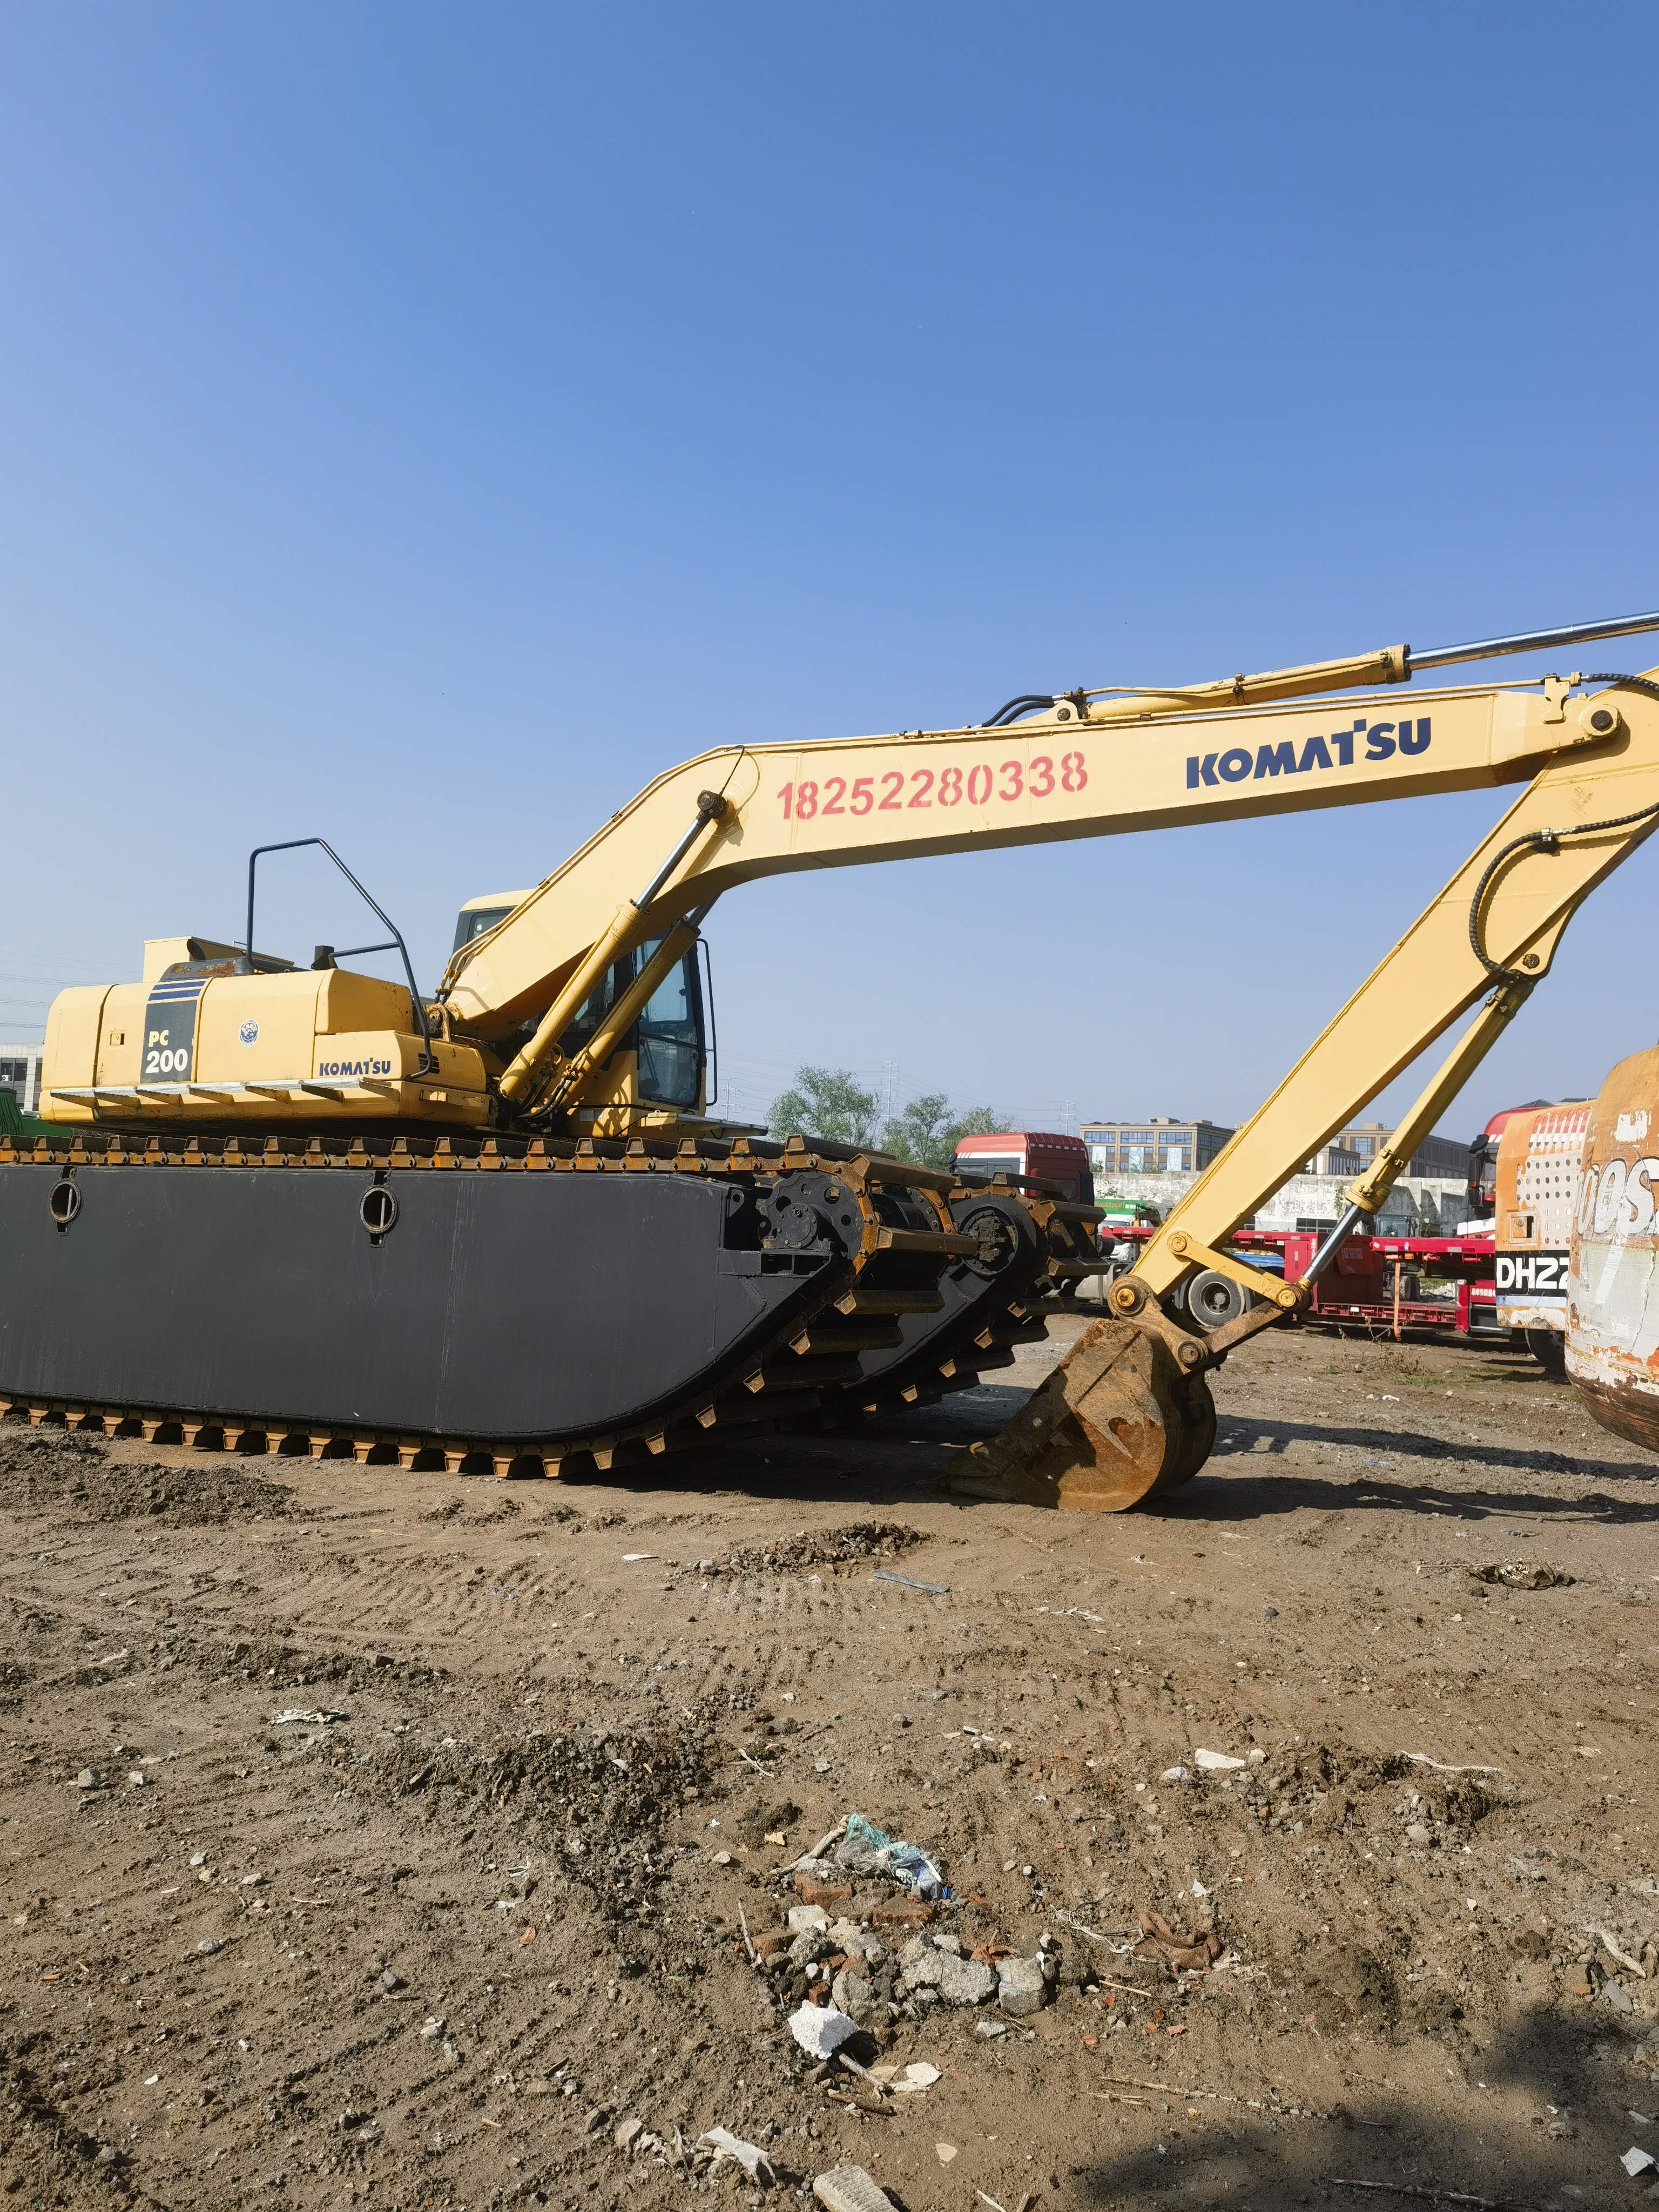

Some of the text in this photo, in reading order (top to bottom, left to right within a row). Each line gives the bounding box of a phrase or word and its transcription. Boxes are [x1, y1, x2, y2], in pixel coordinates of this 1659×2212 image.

[1186, 717, 1431, 789] KOMATSU
[777, 751, 1088, 820] 18252280338
[149, 1030, 169, 1047] PC
[145, 1048, 188, 1073] 200
[319, 1057, 391, 1076] KOMATSU
